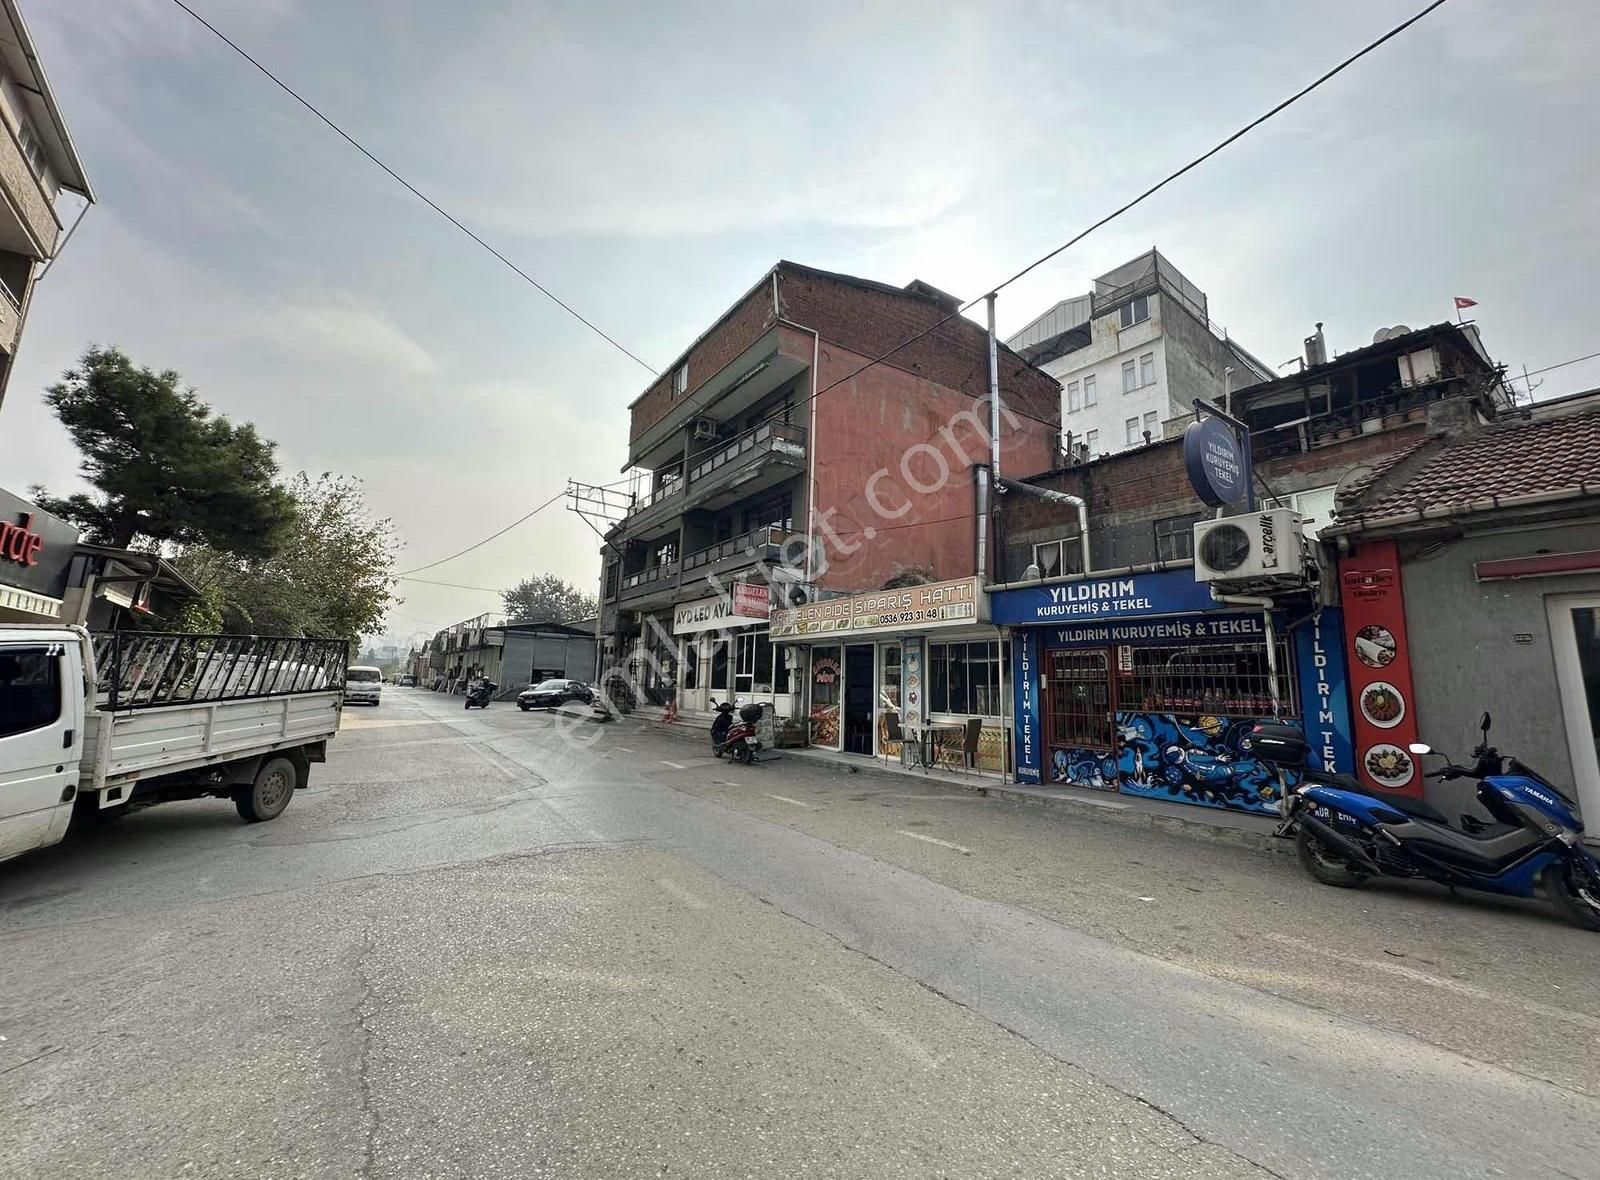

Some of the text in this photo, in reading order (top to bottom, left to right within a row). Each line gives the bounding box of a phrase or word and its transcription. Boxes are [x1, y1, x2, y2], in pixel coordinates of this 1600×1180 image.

[1207, 442, 1234, 461] YILDIRIM
[1215, 467, 1234, 484] TEKEL
[855, 583, 972, 614] SİPARİŞ HATTI
[1050, 580, 1135, 602] YILDIRIM
[676, 610, 692, 625] AYD
[693, 605, 709, 622] LED
[770, 608, 822, 626] KARDELEN
[824, 602, 850, 617] PIDE
[879, 608, 937, 625] 0536 923 31 48
[1037, 598, 1152, 617] KURUYEMİŞ & TEKEL
[1058, 619, 1262, 642] YILDIRIM KURUYEMİŞ & TEKEL
[1312, 614, 1334, 724] YILDIRIM
[1022, 633, 1032, 764] YILDIRIM TEKEL
[1524, 786, 1554, 805] YAMAHA
